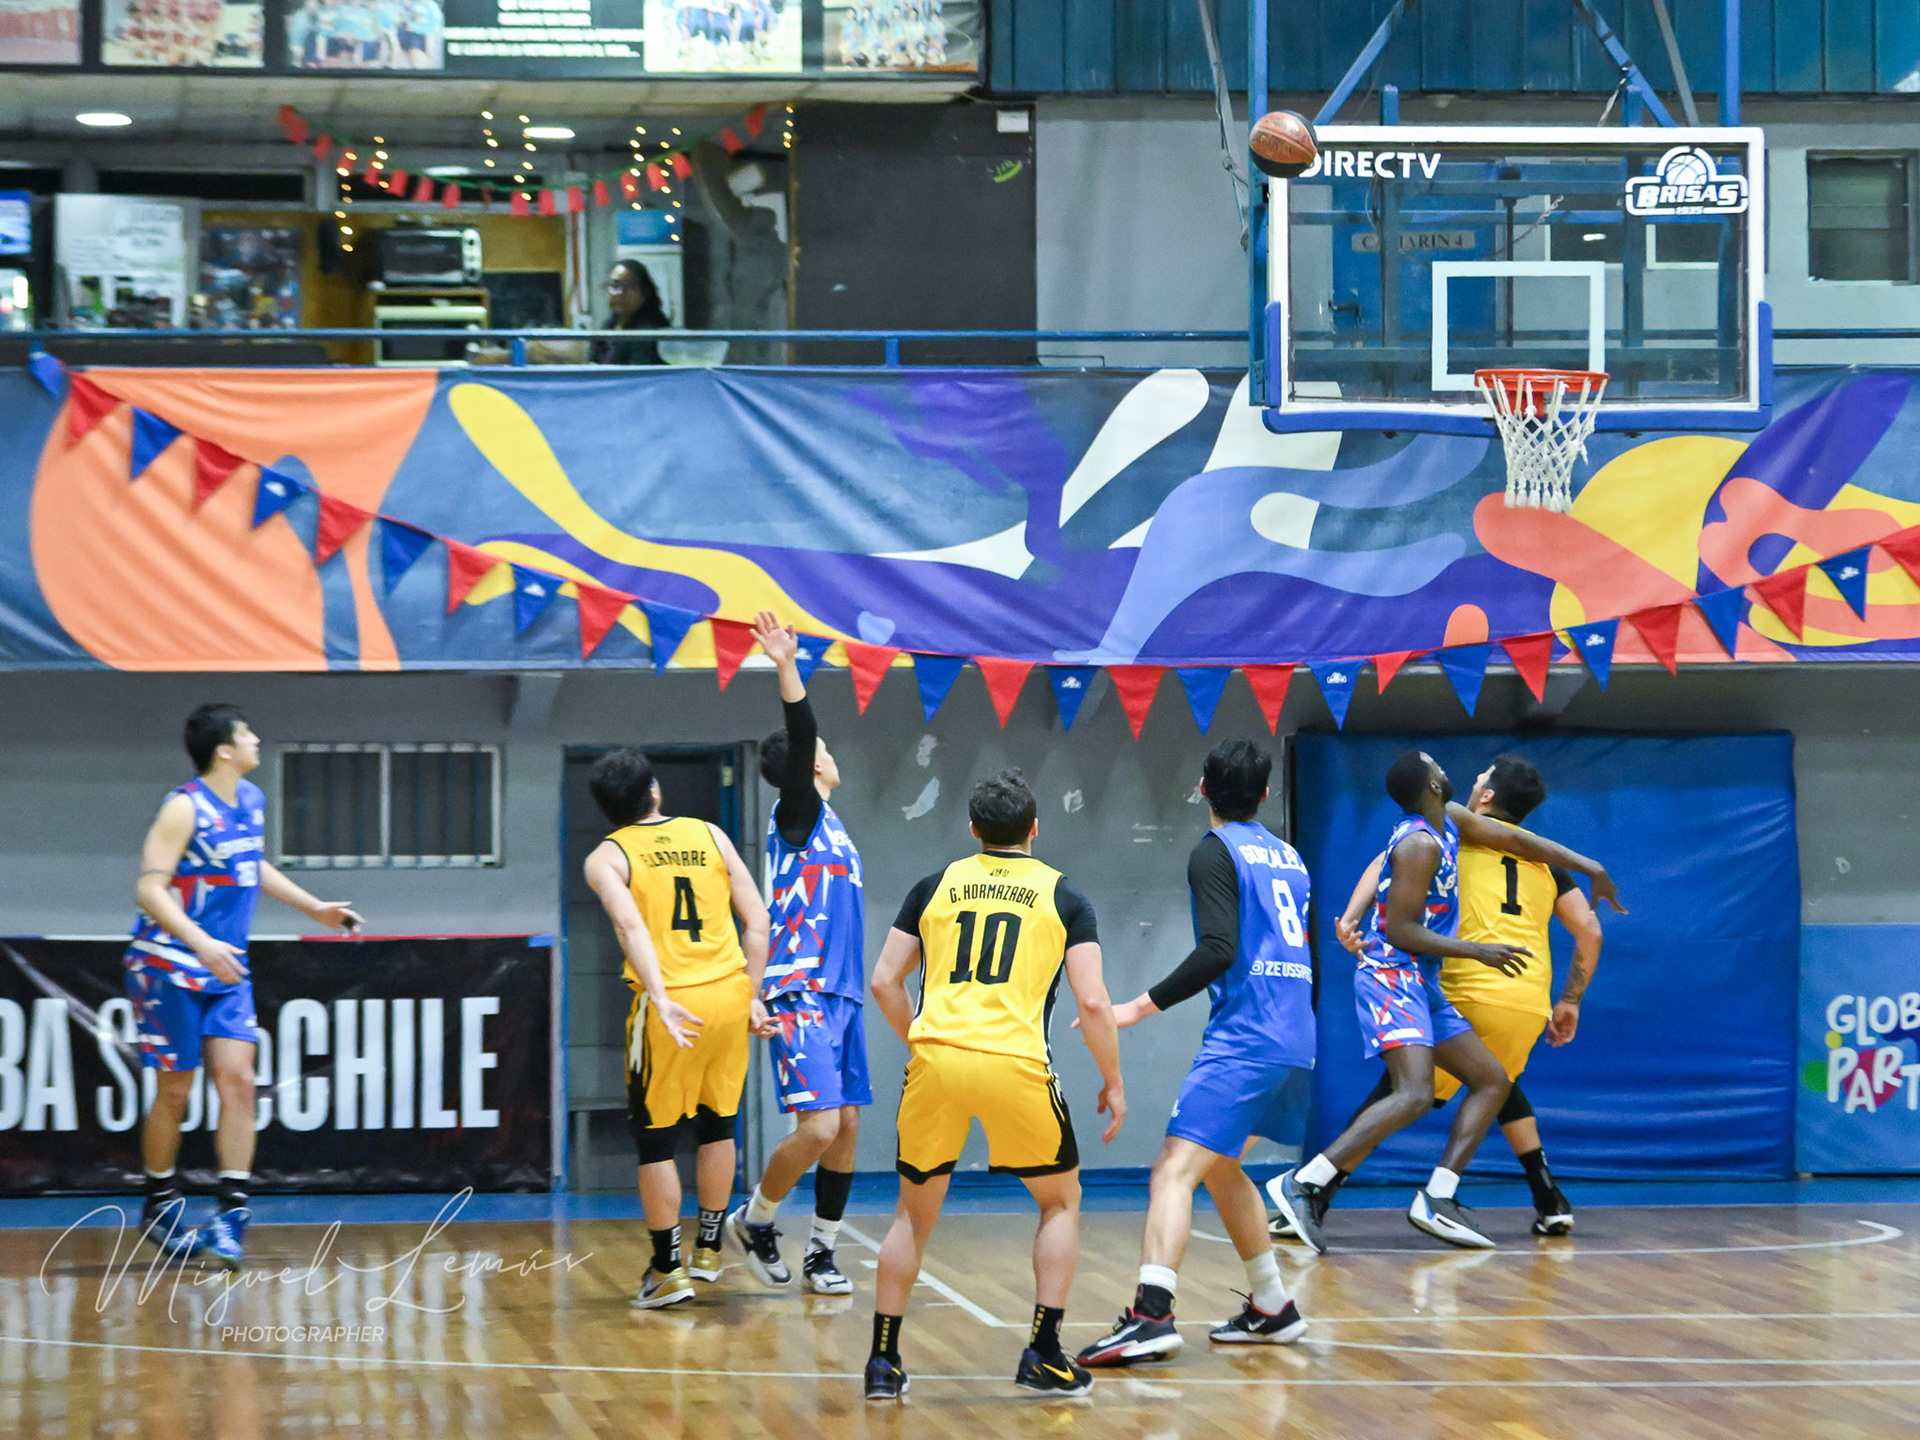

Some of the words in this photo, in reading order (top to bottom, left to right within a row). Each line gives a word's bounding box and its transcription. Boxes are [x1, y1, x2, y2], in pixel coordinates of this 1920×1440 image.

[1299, 150, 1442, 179] DIRECTV
[1636, 184, 1740, 208] BRISAS
[671, 876, 704, 943] 4
[949, 887, 962, 904] G.
[963, 883, 1039, 909] HORMAZABAL
[1271, 878, 1305, 948] 8
[1501, 855, 1522, 916] 1
[949, 910, 1023, 985] 10
